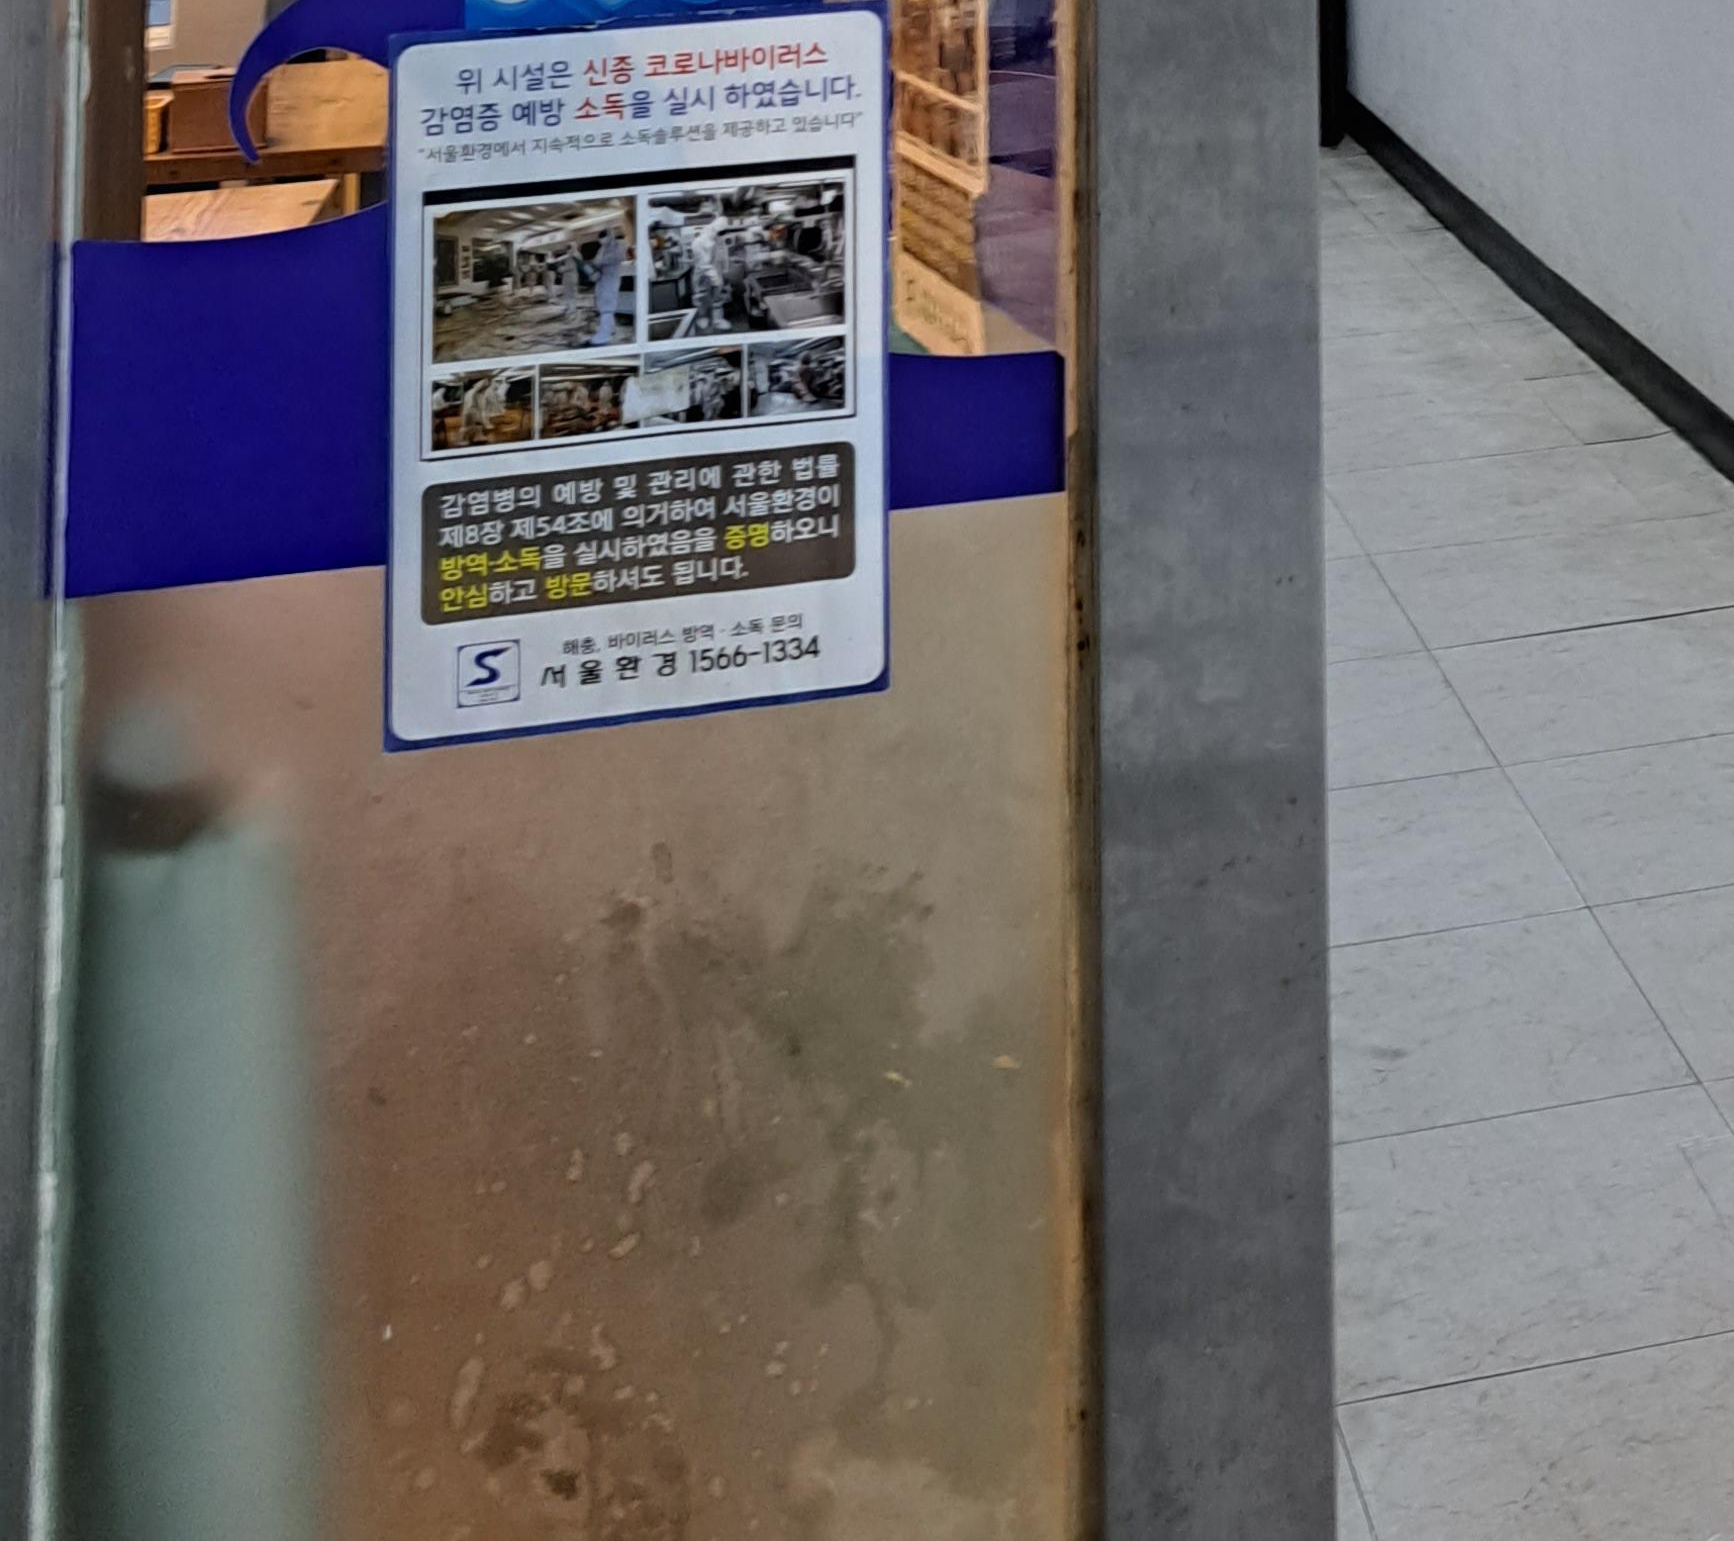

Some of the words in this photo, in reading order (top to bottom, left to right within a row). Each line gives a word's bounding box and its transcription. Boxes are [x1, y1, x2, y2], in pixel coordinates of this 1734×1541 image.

[456, 68, 483, 96] 위
[493, 60, 573, 93] 시설은
[583, 56, 634, 87] 신종
[644, 42, 829, 77] 코로나바이러스
[420, 103, 503, 137] 감염증
[512, 97, 565, 127] 예방
[575, 88, 654, 121] 소독을
[664, 85, 715, 116] 실시
[724, 74, 862, 109] 하였습니다.
[531, 132, 615, 154] 지속적으로
[619, 122, 716, 147] 소독솔루션을
[722, 118, 788, 138] 제공하고
[440, 484, 541, 519] 감염병의
[552, 478, 603, 505] 예방
[613, 474, 637, 500] 및
[648, 465, 721, 496] 관리에
[731, 460, 782, 488] 관한
[792, 453, 840, 481] 법률
[439, 519, 504, 548] 제8장
[510, 508, 613, 539] 제54조에
[621, 496, 716, 529] 의거하여
[722, 484, 841, 518] 서울환경이
[573, 527, 717, 566] 실시하였음을
[724, 514, 840, 551] 증명하오니
[440, 579, 537, 613] 안심하고
[545, 565, 666, 600] 방문하셔도
[671, 555, 749, 586] 됩니다.
[608, 628, 676, 649] 바이러스
[682, 624, 714, 643] 방역
[730, 617, 765, 636] 소독
[770, 613, 803, 633] 문의
[540, 651, 677, 688] 서울환경
[690, 635, 820, 673] 1566-1334
